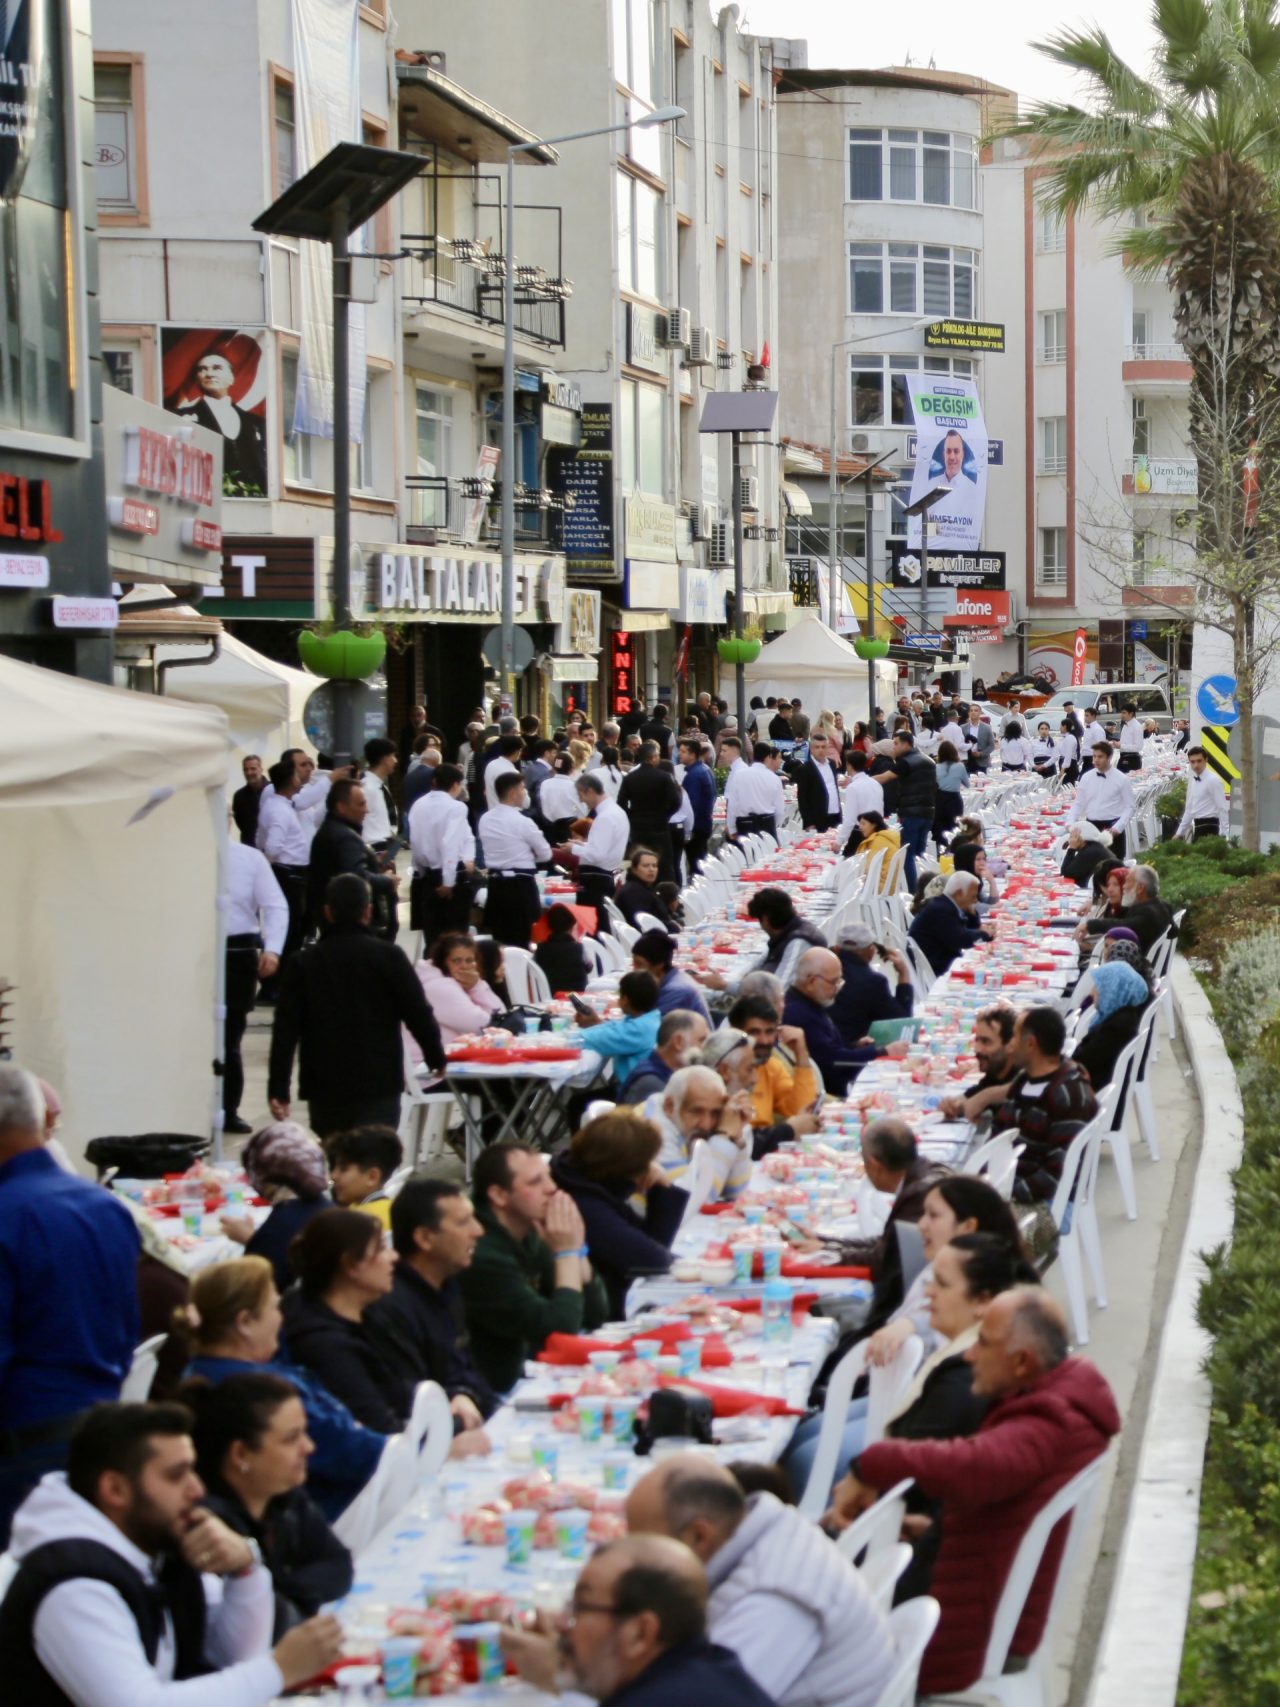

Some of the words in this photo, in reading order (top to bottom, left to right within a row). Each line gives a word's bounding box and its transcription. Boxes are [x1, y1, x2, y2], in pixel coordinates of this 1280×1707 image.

[921, 397, 974, 415] DEĞİŞİM
[936, 417, 967, 428] BAŞLIYOR
[929, 514, 953, 524] HMET
[927, 554, 1001, 573] PAMİRLER
[956, 599, 992, 616] afone
